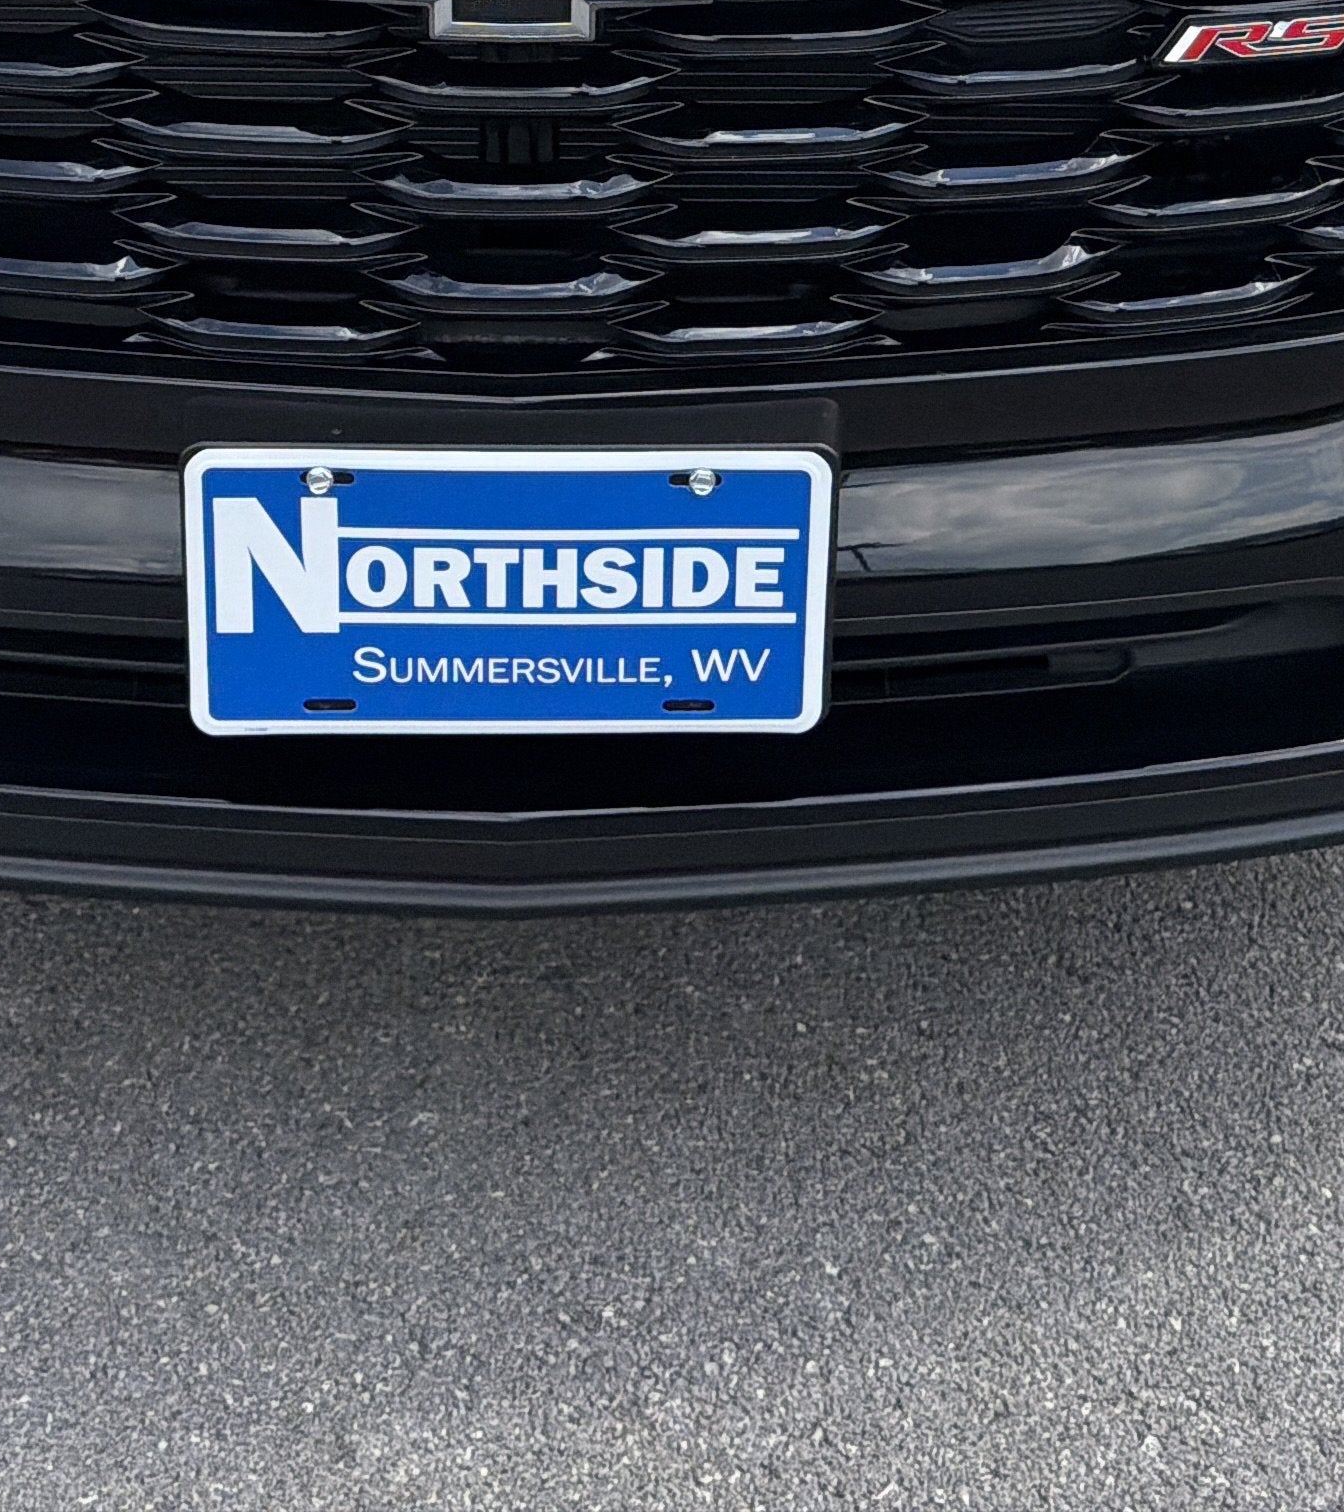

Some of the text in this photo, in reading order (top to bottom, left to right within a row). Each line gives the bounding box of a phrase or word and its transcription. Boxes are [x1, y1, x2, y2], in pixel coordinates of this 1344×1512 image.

[212, 497, 785, 634] NORTHSIDE
[352, 646, 771, 688] SUMMERSVILLE, WV
